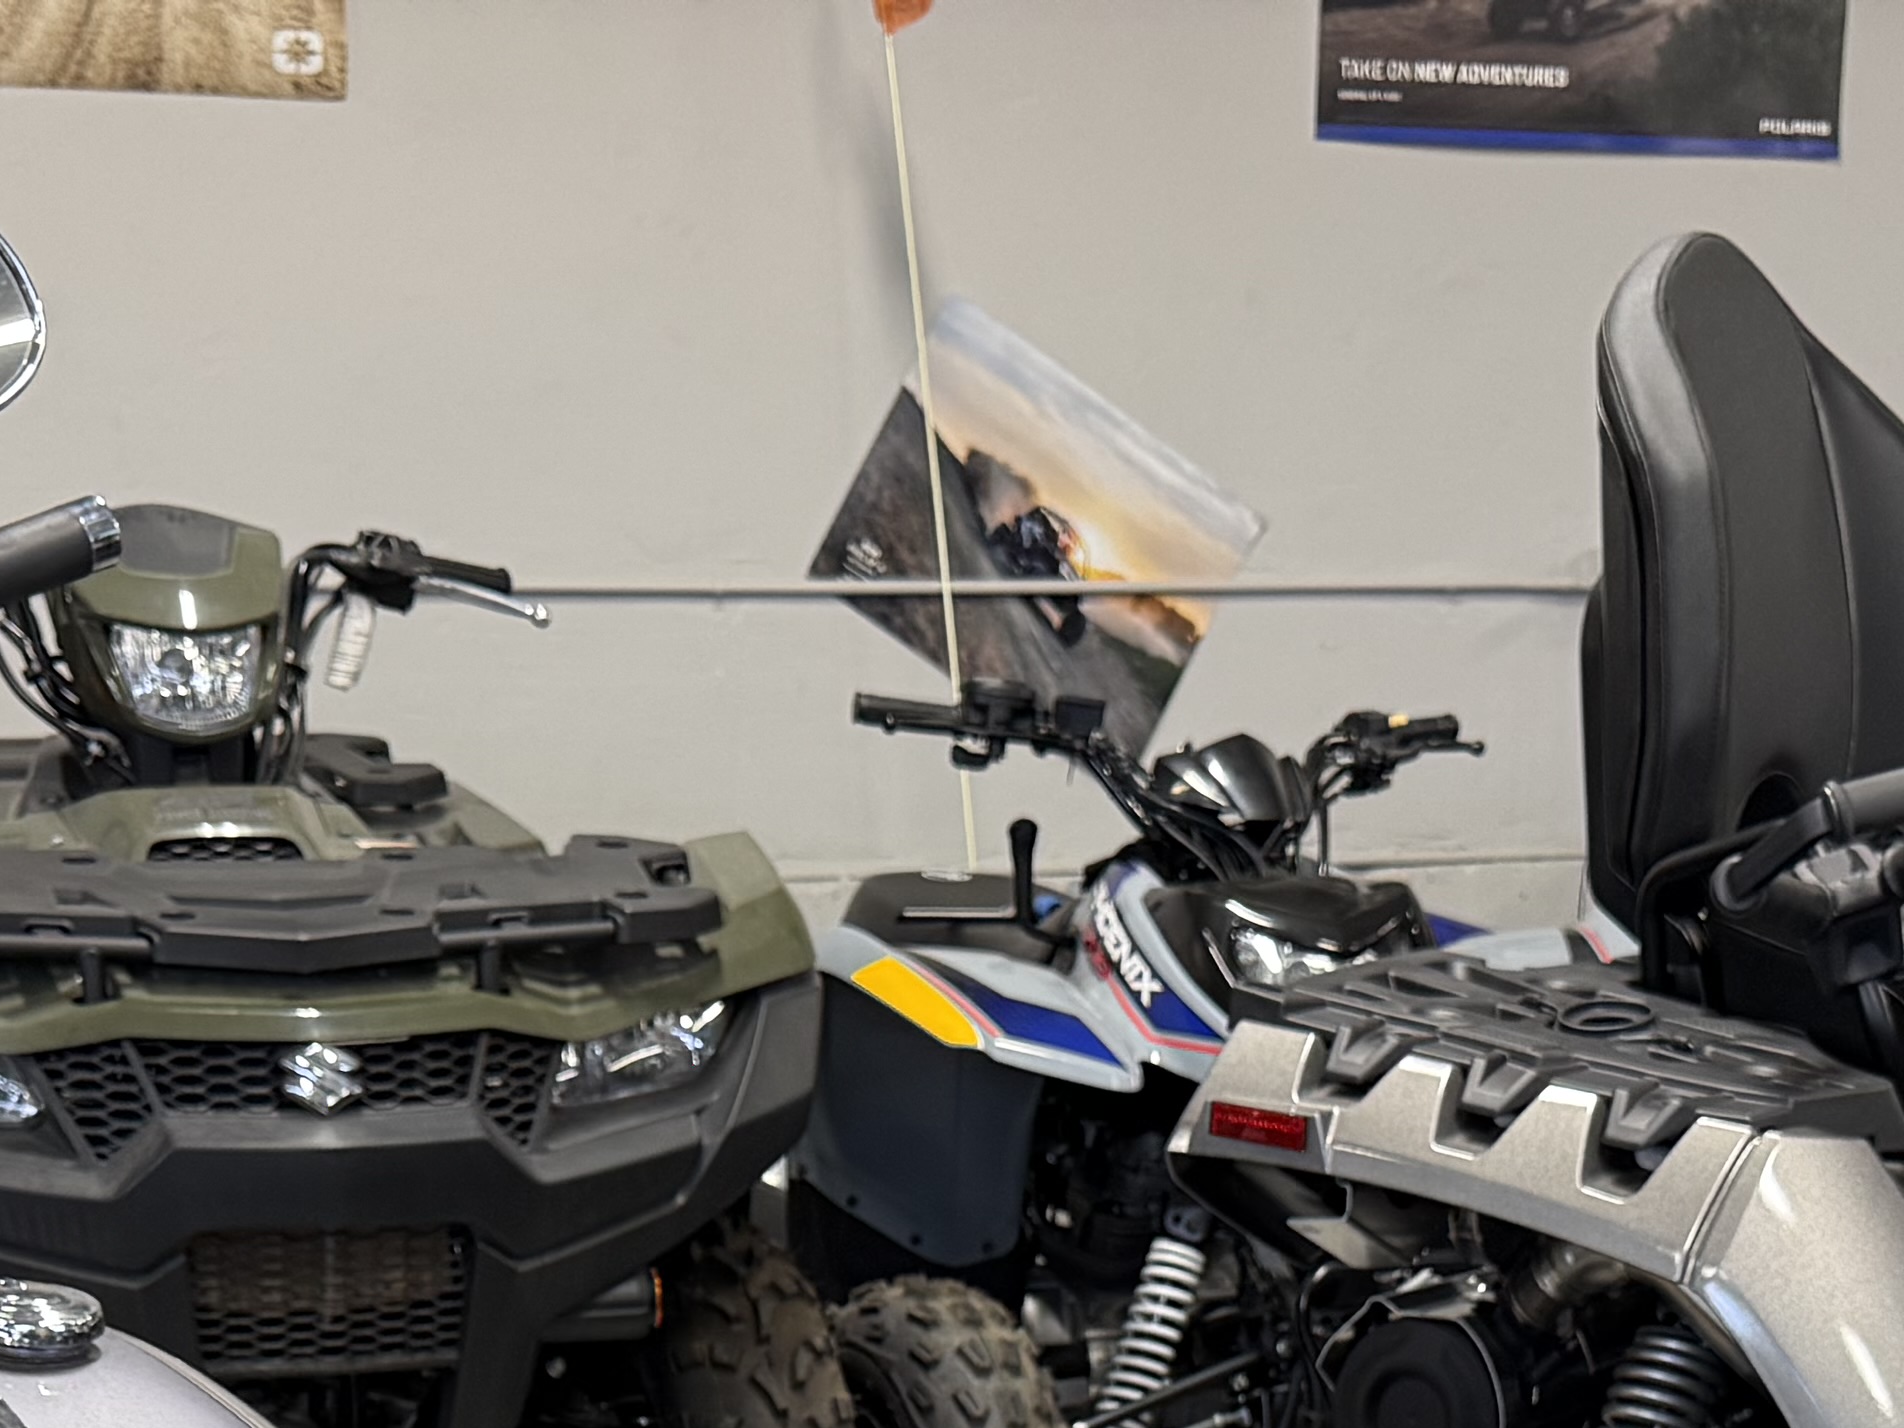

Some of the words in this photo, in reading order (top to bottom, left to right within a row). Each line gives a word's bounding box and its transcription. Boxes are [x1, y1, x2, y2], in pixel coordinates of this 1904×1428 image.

[1339, 57, 1386, 82] TAKE
[1387, 59, 1413, 83] ON
[1414, 60, 1456, 84] NEW
[1456, 61, 1570, 88] ADVENTURES
